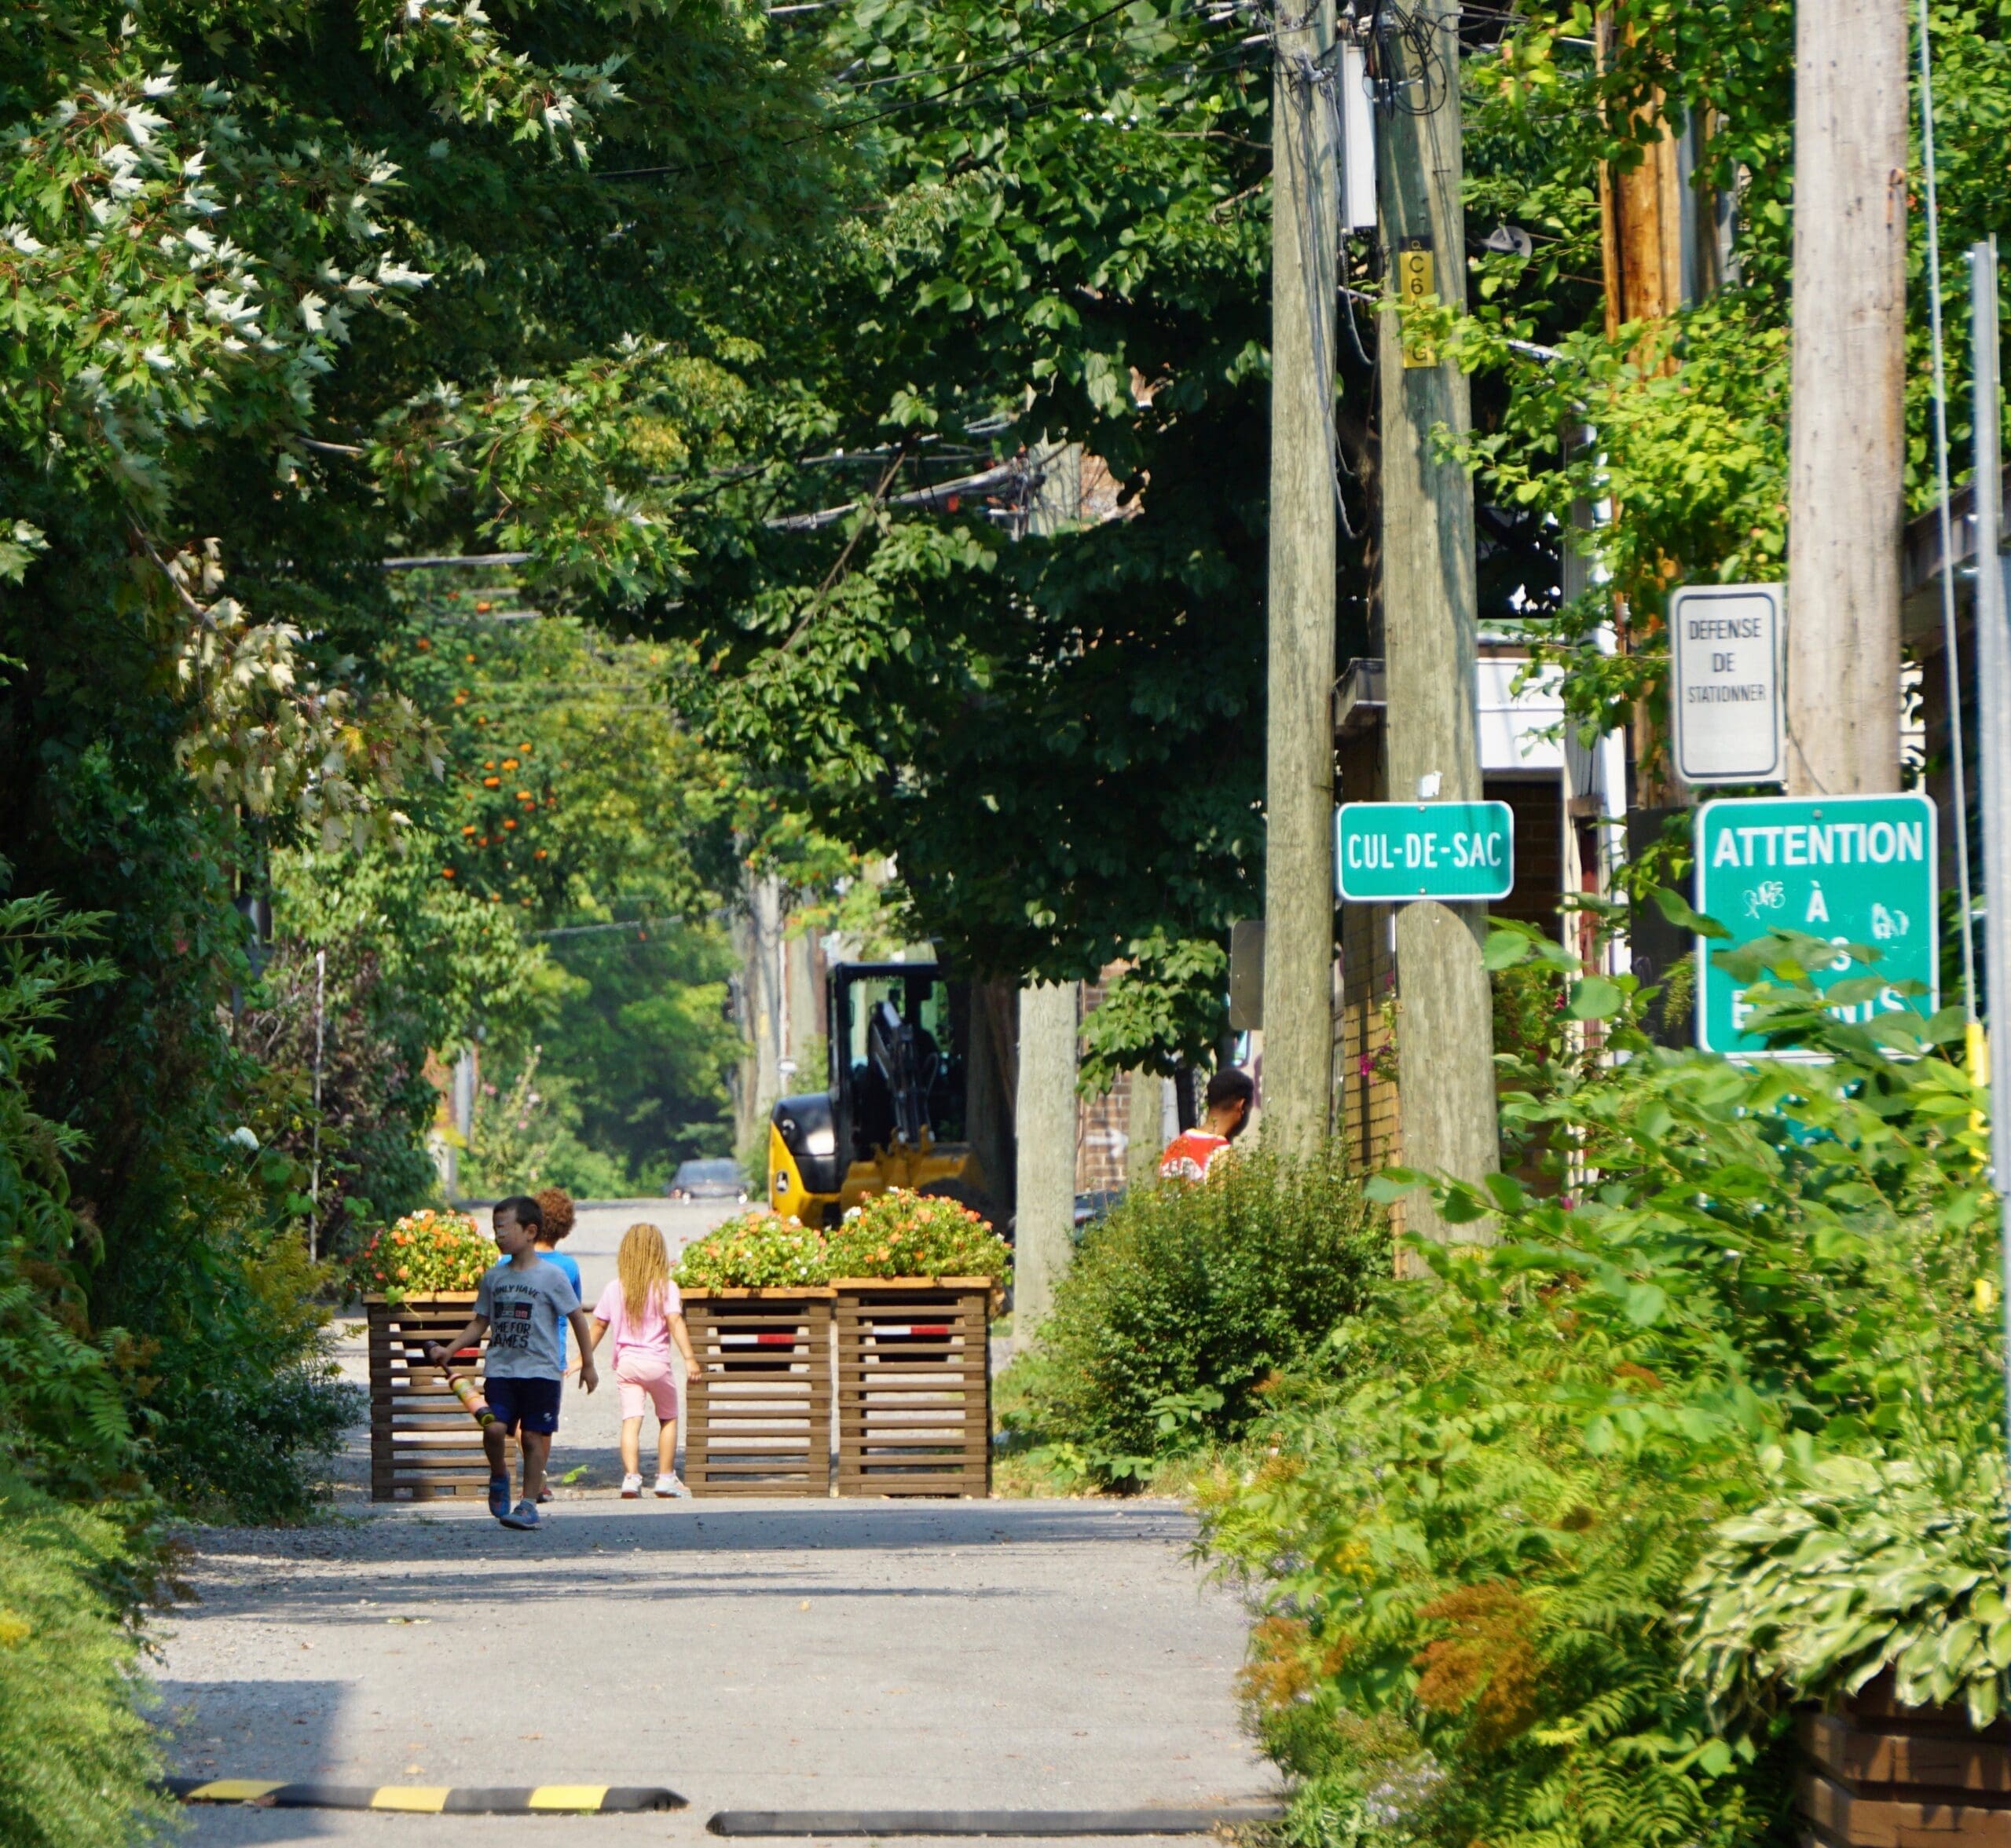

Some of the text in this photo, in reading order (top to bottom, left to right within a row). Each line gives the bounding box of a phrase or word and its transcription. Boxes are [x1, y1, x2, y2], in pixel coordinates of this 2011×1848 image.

[1688, 617, 1762, 640] DEFENSE
[1712, 653, 1735, 673] DE
[1688, 684, 1766, 704] STATIONNER
[1348, 832, 1502, 869] CUL-DE-SAC
[1712, 821, 1923, 867] ATTENTION
[1804, 880, 1830, 923] À
[515, 1284, 540, 1298] HAVE
[511, 1322, 531, 1334] FOR
